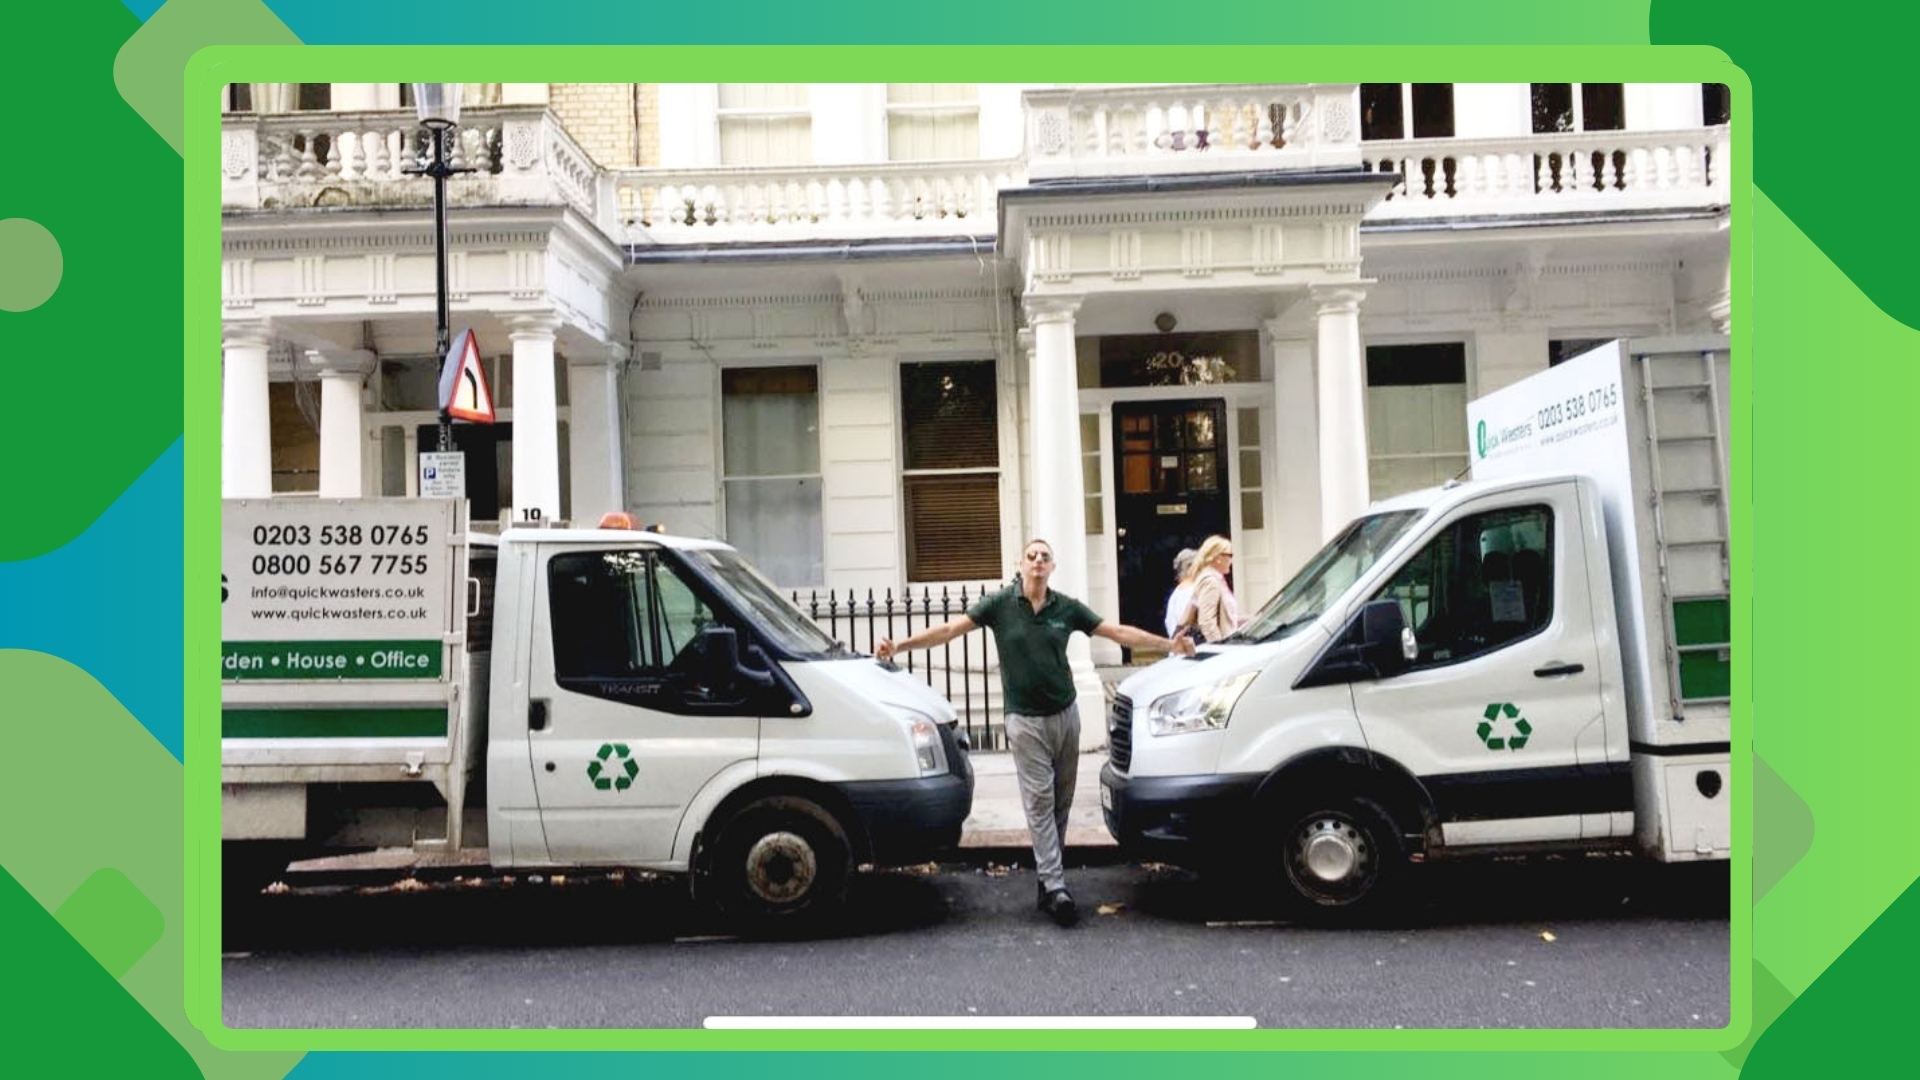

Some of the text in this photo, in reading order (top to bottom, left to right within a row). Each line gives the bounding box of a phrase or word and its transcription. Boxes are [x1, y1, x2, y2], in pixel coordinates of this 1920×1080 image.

[1538, 383, 1617, 430] 0203 538 0765
[252, 525, 429, 546] 0203 538 0765
[252, 554, 428, 575] 0800 567 7755
[251, 586, 425, 600] info@quickwasters.co.uk
[251, 607, 427, 622] www.quickwasters.co.uk
[287, 652, 347, 669] House
[371, 651, 430, 668] Office
